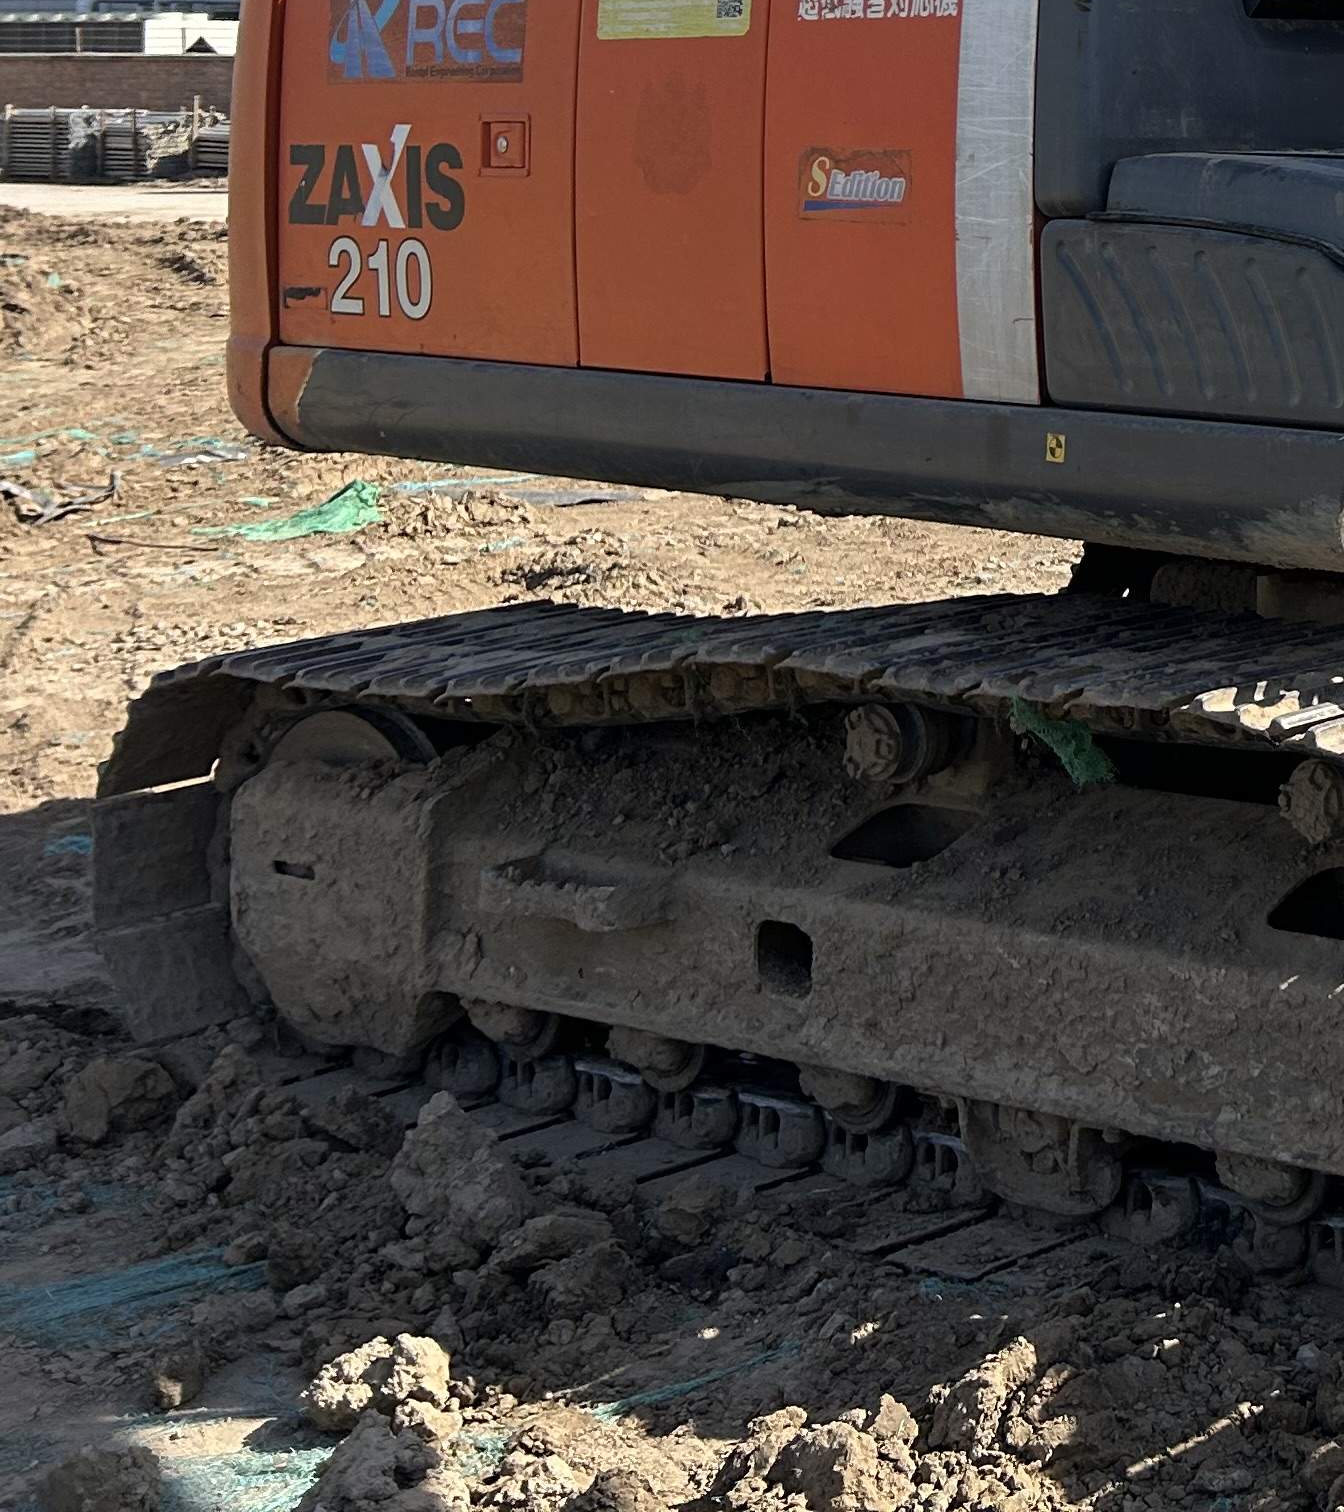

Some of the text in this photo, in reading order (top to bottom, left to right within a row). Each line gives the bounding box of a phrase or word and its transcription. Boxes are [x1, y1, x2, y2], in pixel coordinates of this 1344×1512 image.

[289, 123, 466, 232] ZAXIS
[827, 169, 907, 202] Edition
[328, 235, 434, 321] 210
